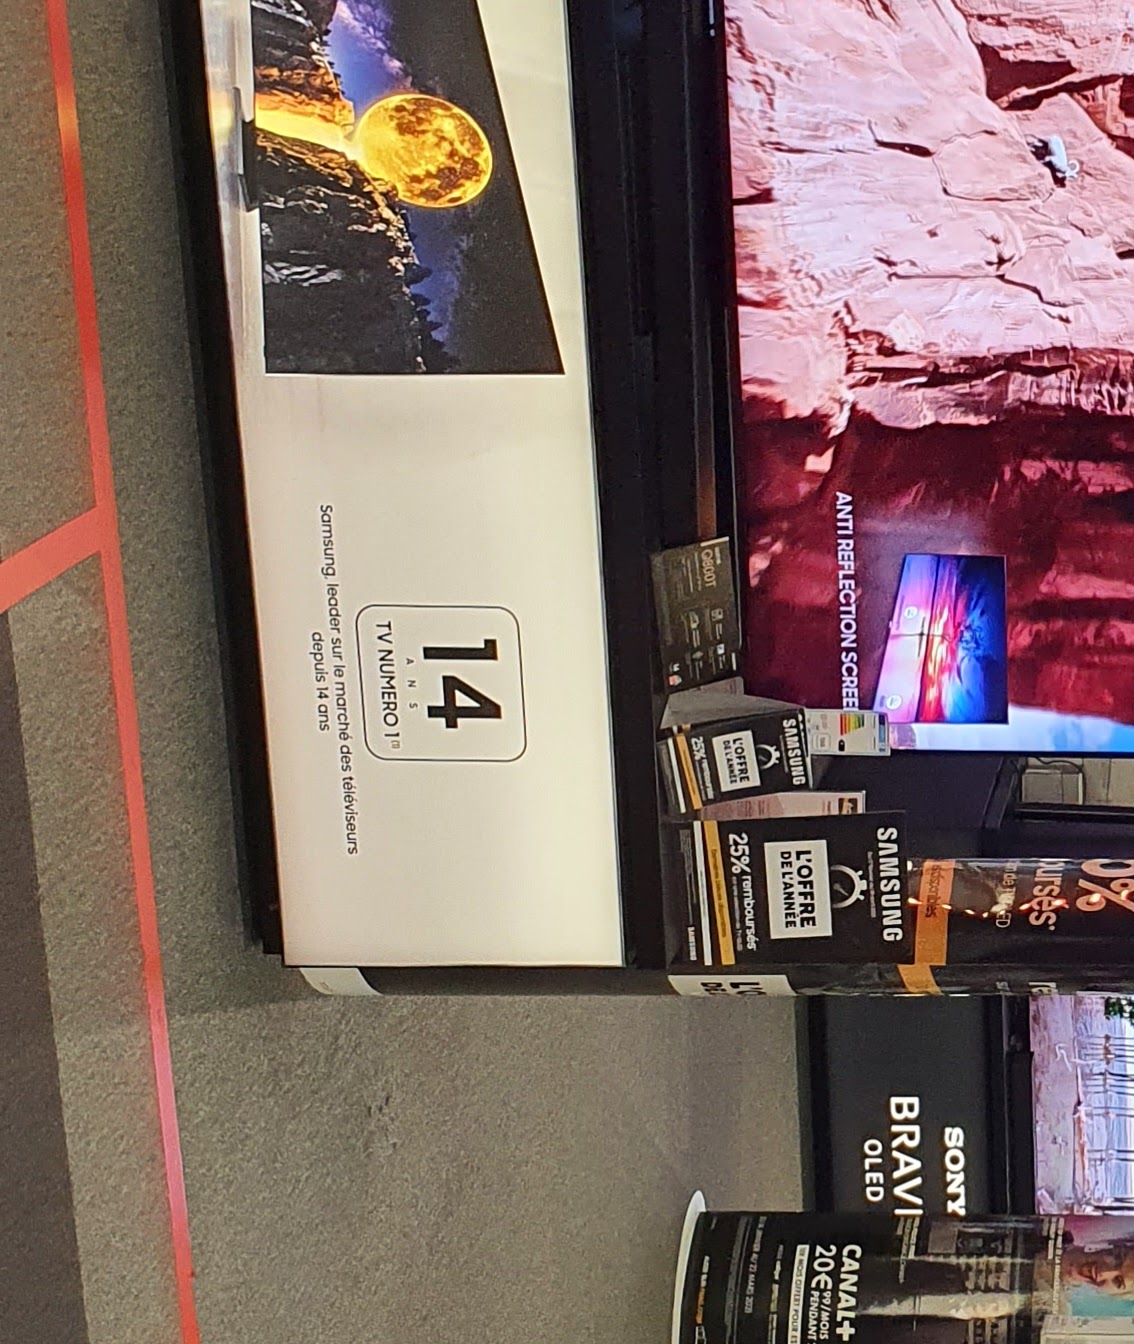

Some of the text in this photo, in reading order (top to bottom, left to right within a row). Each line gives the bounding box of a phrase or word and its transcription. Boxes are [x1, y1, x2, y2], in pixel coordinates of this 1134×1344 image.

[835, 491, 854, 536] ANTI
[837, 539, 857, 647] REFLECTION
[308, 632, 330, 733] depuis 14 ans
[317, 504, 360, 856] Samsung, leader sur le marché des téléviseurs
[375, 620, 400, 728] TV NUMERO
[422, 638, 502, 729] 14
[690, 736, 707, 760] 25%
[722, 739, 732, 751] DE
[732, 737, 750, 784] L'OFFRE
[782, 718, 806, 786] SAMSUNG
[728, 833, 751, 874] 25%
[780, 851, 799, 929] DE L'ANNÉE
[795, 850, 816, 928] L'OFFRE
[876, 827, 903, 942] SAMSUNG
[688, 926, 697, 961] SAMSUNG
[863, 1138, 885, 1202] OLED
[944, 1126, 966, 1216] SONY
[808, 1290, 820, 1341] PENDANT
[835, 1244, 862, 1342] CANAL+
